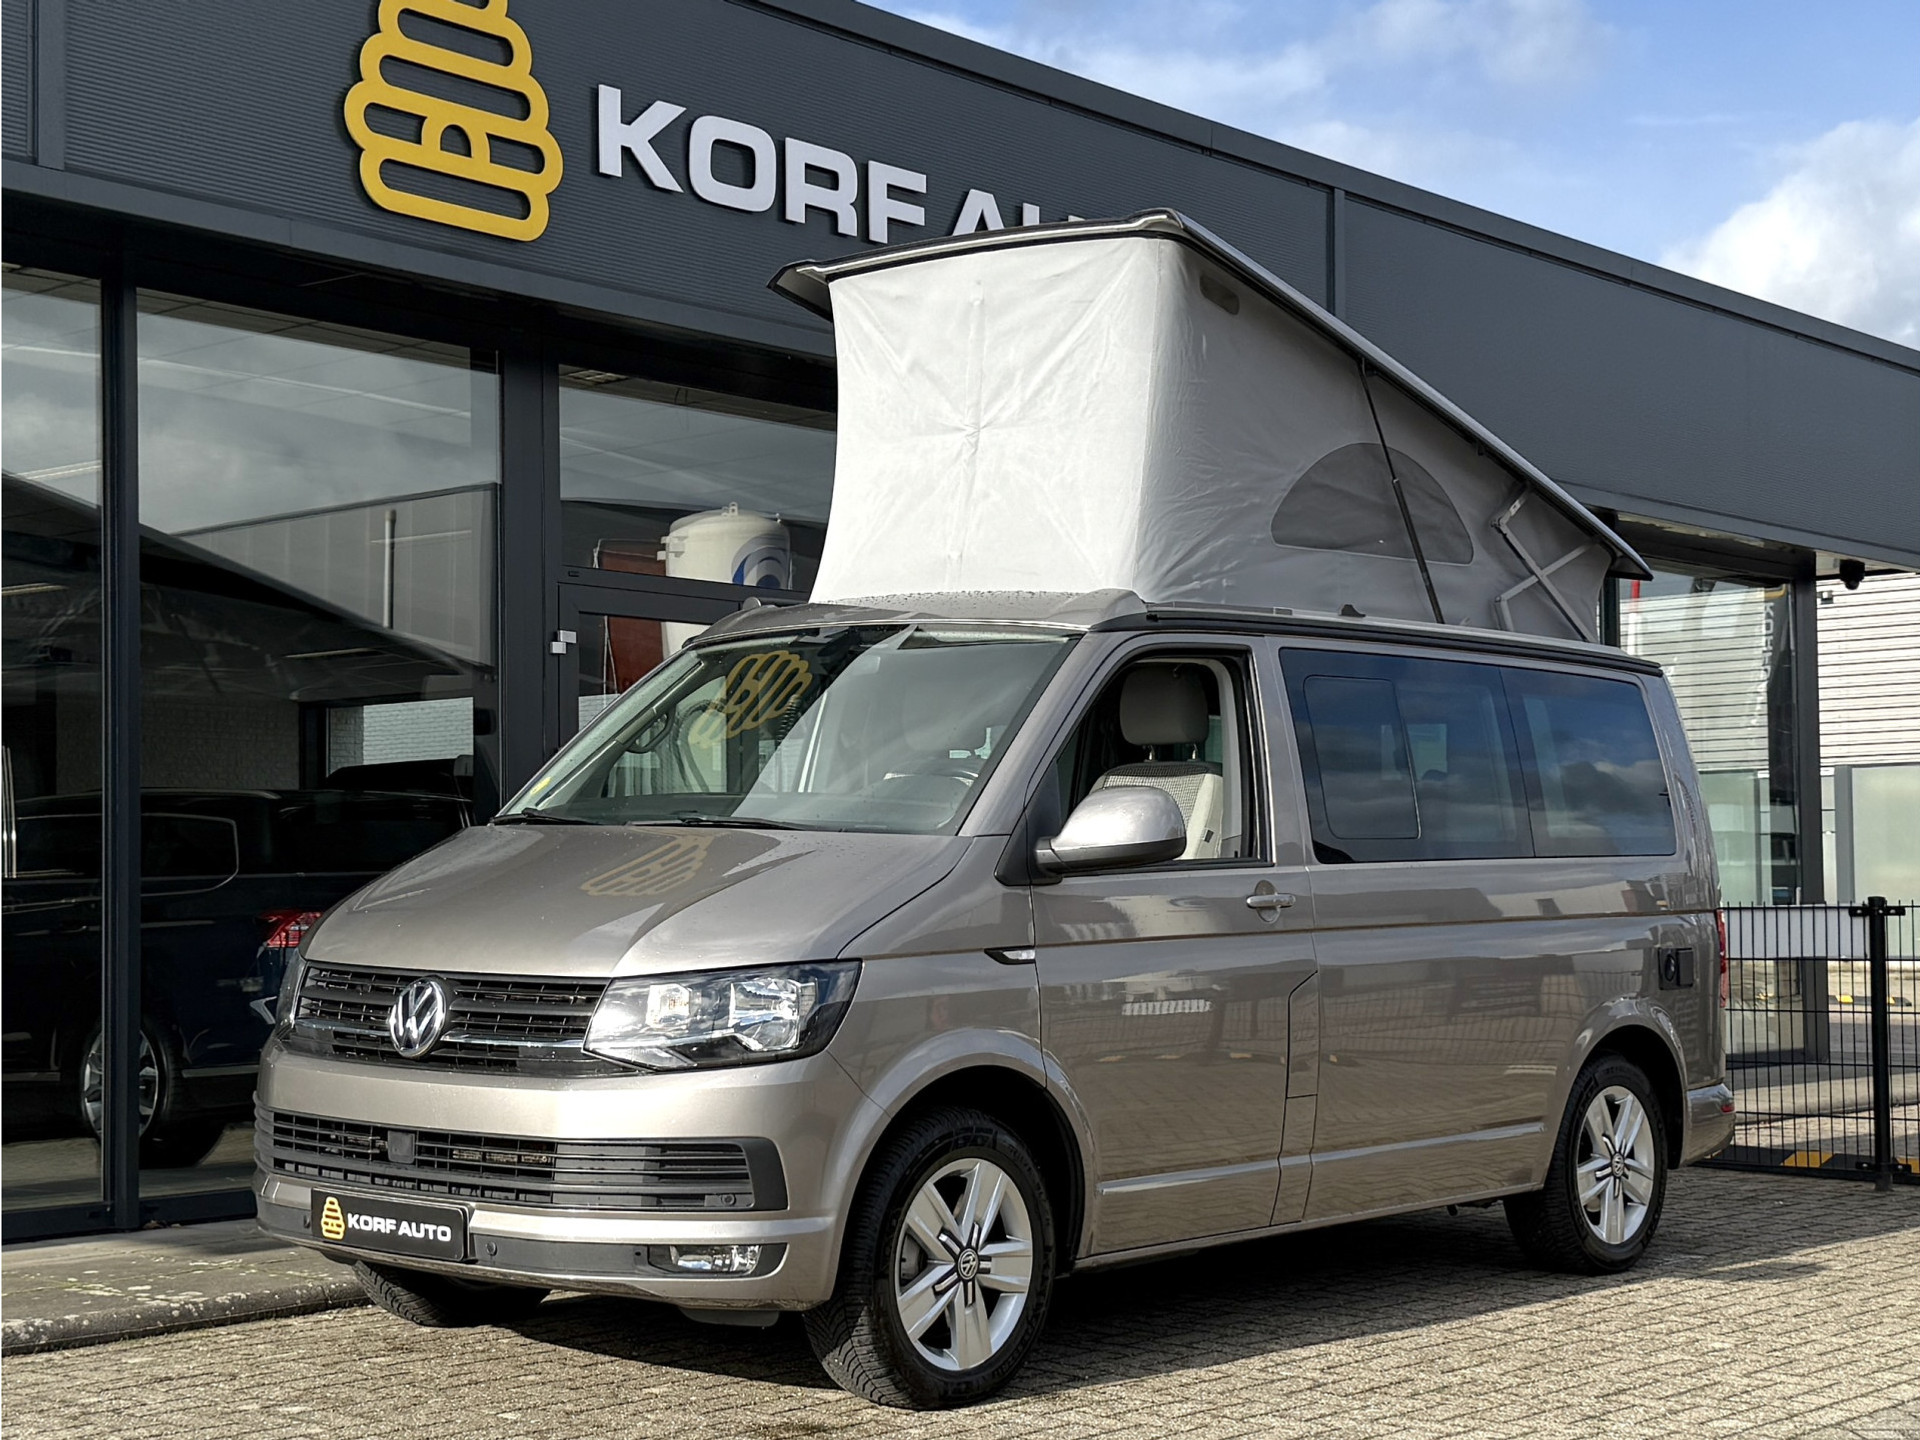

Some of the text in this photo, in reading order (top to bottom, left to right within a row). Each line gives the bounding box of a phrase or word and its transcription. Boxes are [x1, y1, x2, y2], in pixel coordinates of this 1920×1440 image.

[598, 83, 927, 244] KORF
[347, 1212, 452, 1242] KORF AUTO
